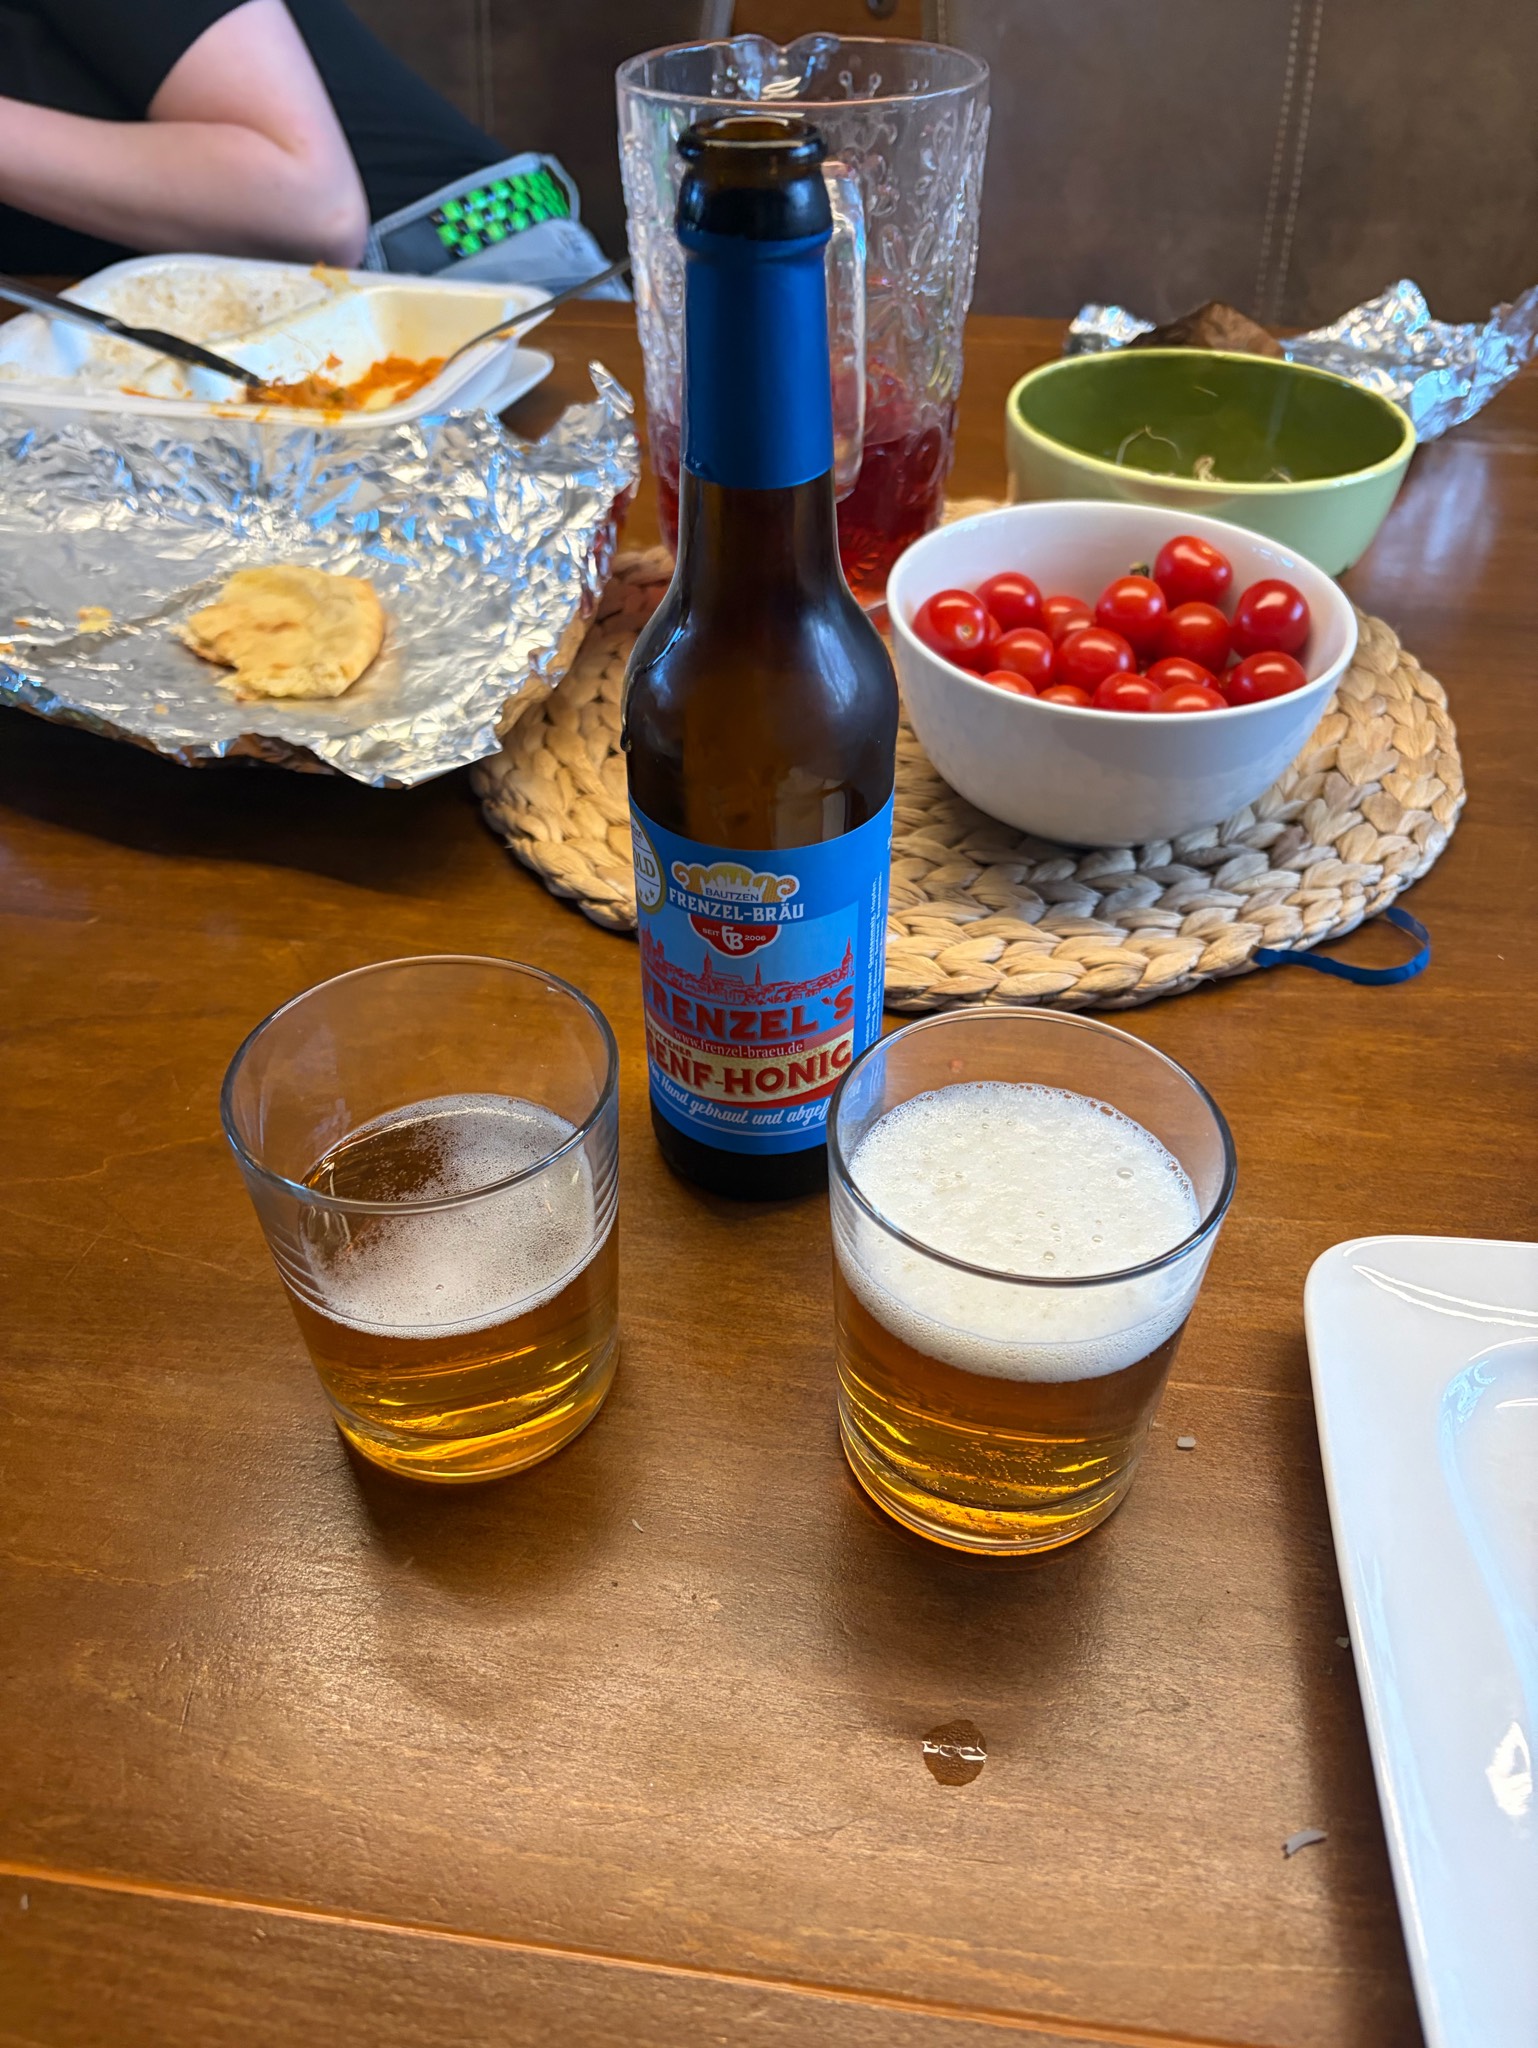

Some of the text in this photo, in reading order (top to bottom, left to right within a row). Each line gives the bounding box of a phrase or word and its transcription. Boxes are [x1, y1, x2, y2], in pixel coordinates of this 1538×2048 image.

[633, 848, 657, 878] OLD
[669, 886, 804, 922] FRENZEL-BRÄU
[705, 887, 760, 902] BAUTZEN
[702, 927, 720, 937] SEIT
[744, 934, 766, 942] 2006
[674, 1029, 804, 1060] www.frenzel-braeu.de
[661, 1075, 688, 1106] Hand
[688, 1100, 749, 1125] gebraut
[752, 1109, 783, 1126] und
